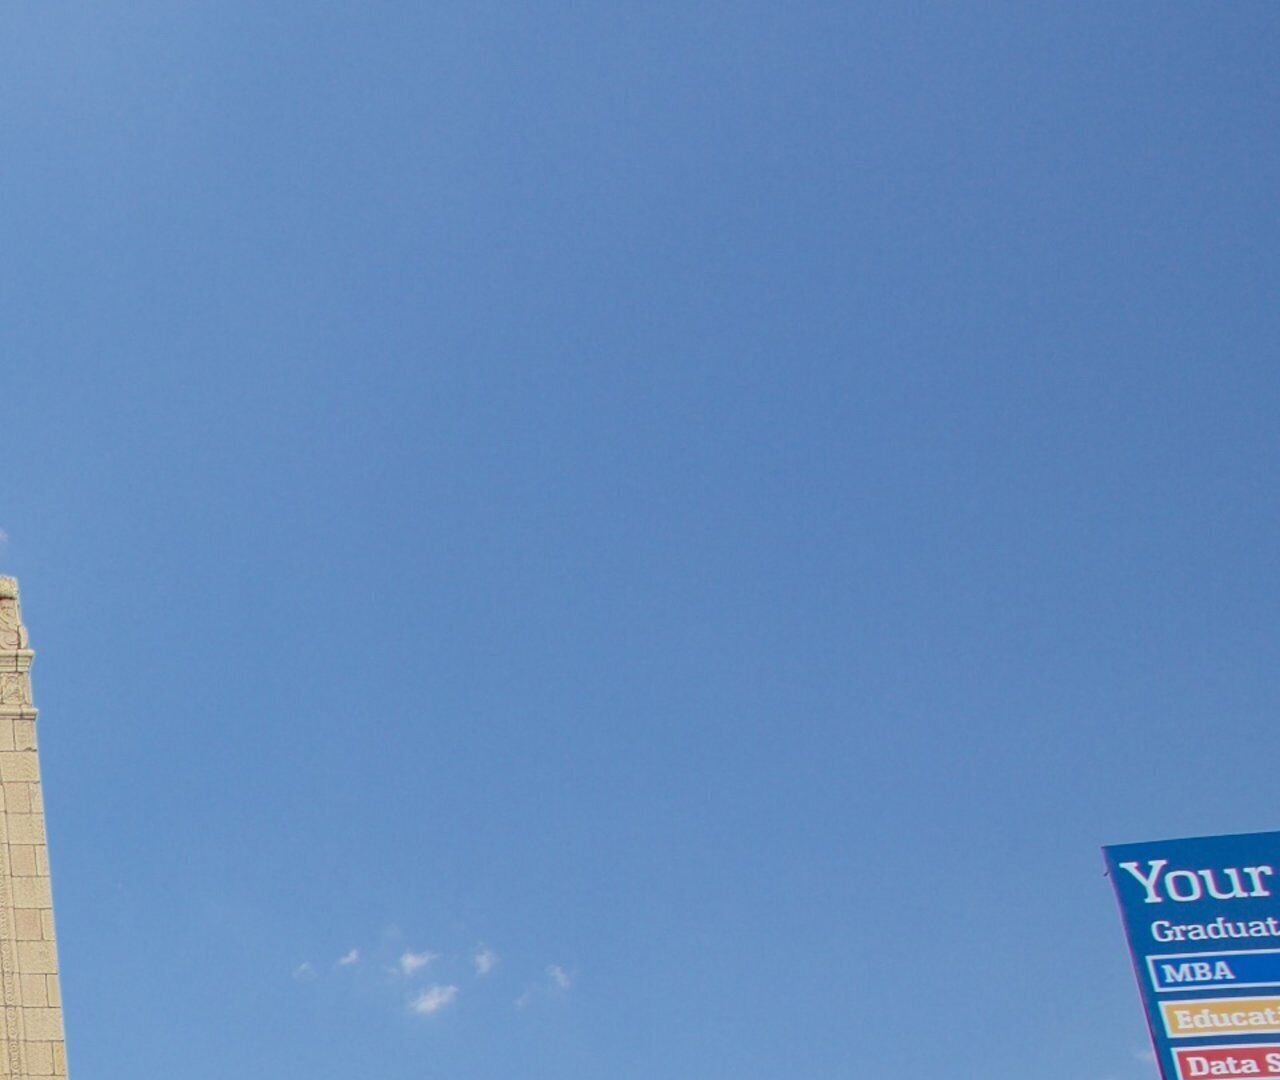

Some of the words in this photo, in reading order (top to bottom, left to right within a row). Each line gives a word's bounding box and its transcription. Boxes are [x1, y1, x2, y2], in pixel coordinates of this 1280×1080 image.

[1119, 859, 1273, 903] Your
[1162, 961, 1235, 983] MBA
[1186, 1056, 1260, 1076] Data
